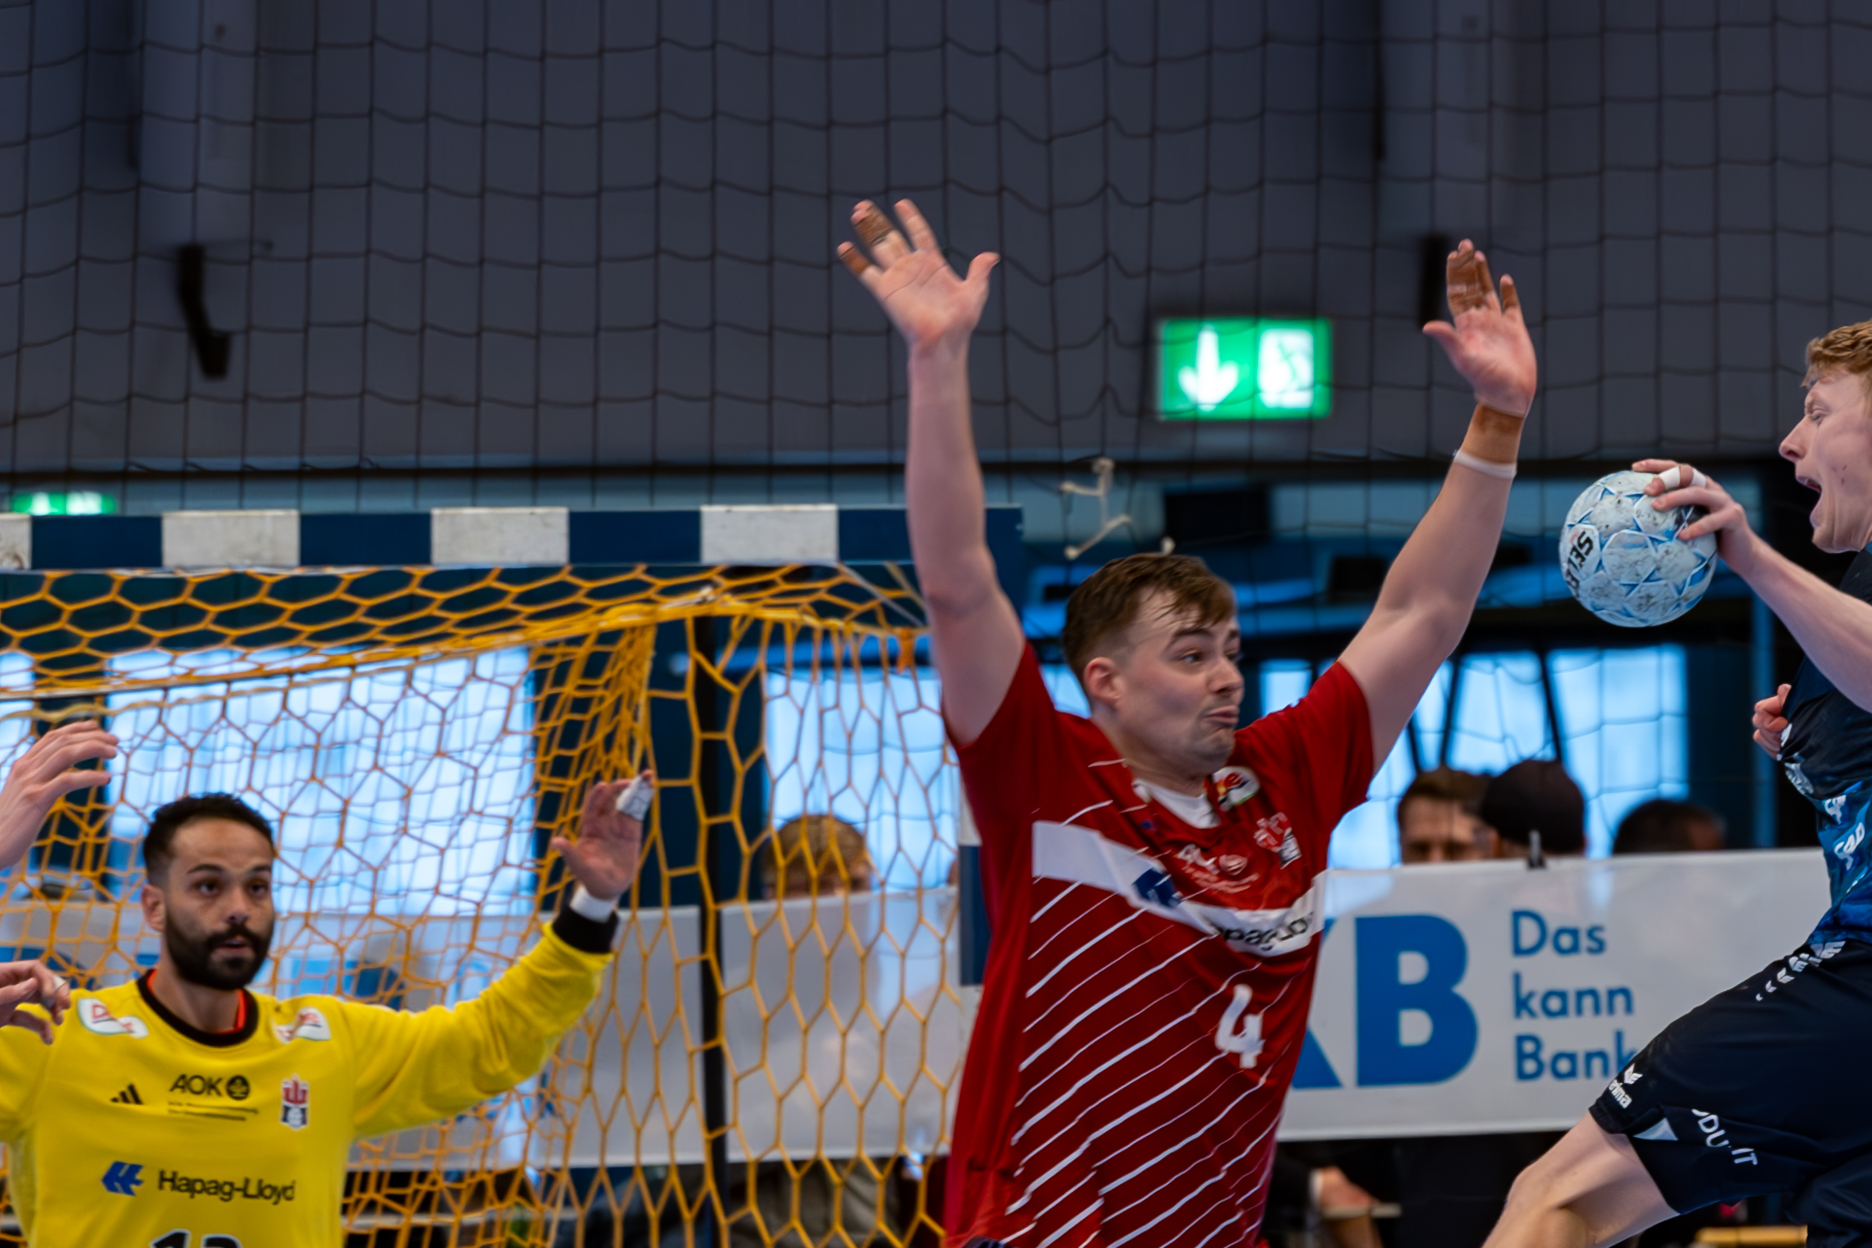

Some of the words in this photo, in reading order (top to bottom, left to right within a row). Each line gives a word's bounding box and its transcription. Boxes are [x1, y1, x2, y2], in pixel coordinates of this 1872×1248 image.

[1511, 908, 1607, 957] Das
[1513, 971, 1634, 1020] kann
[1214, 983, 1266, 1069] 4
[169, 1074, 223, 1098] AOK
[157, 1168, 297, 1206] Hapag-Lloyd
